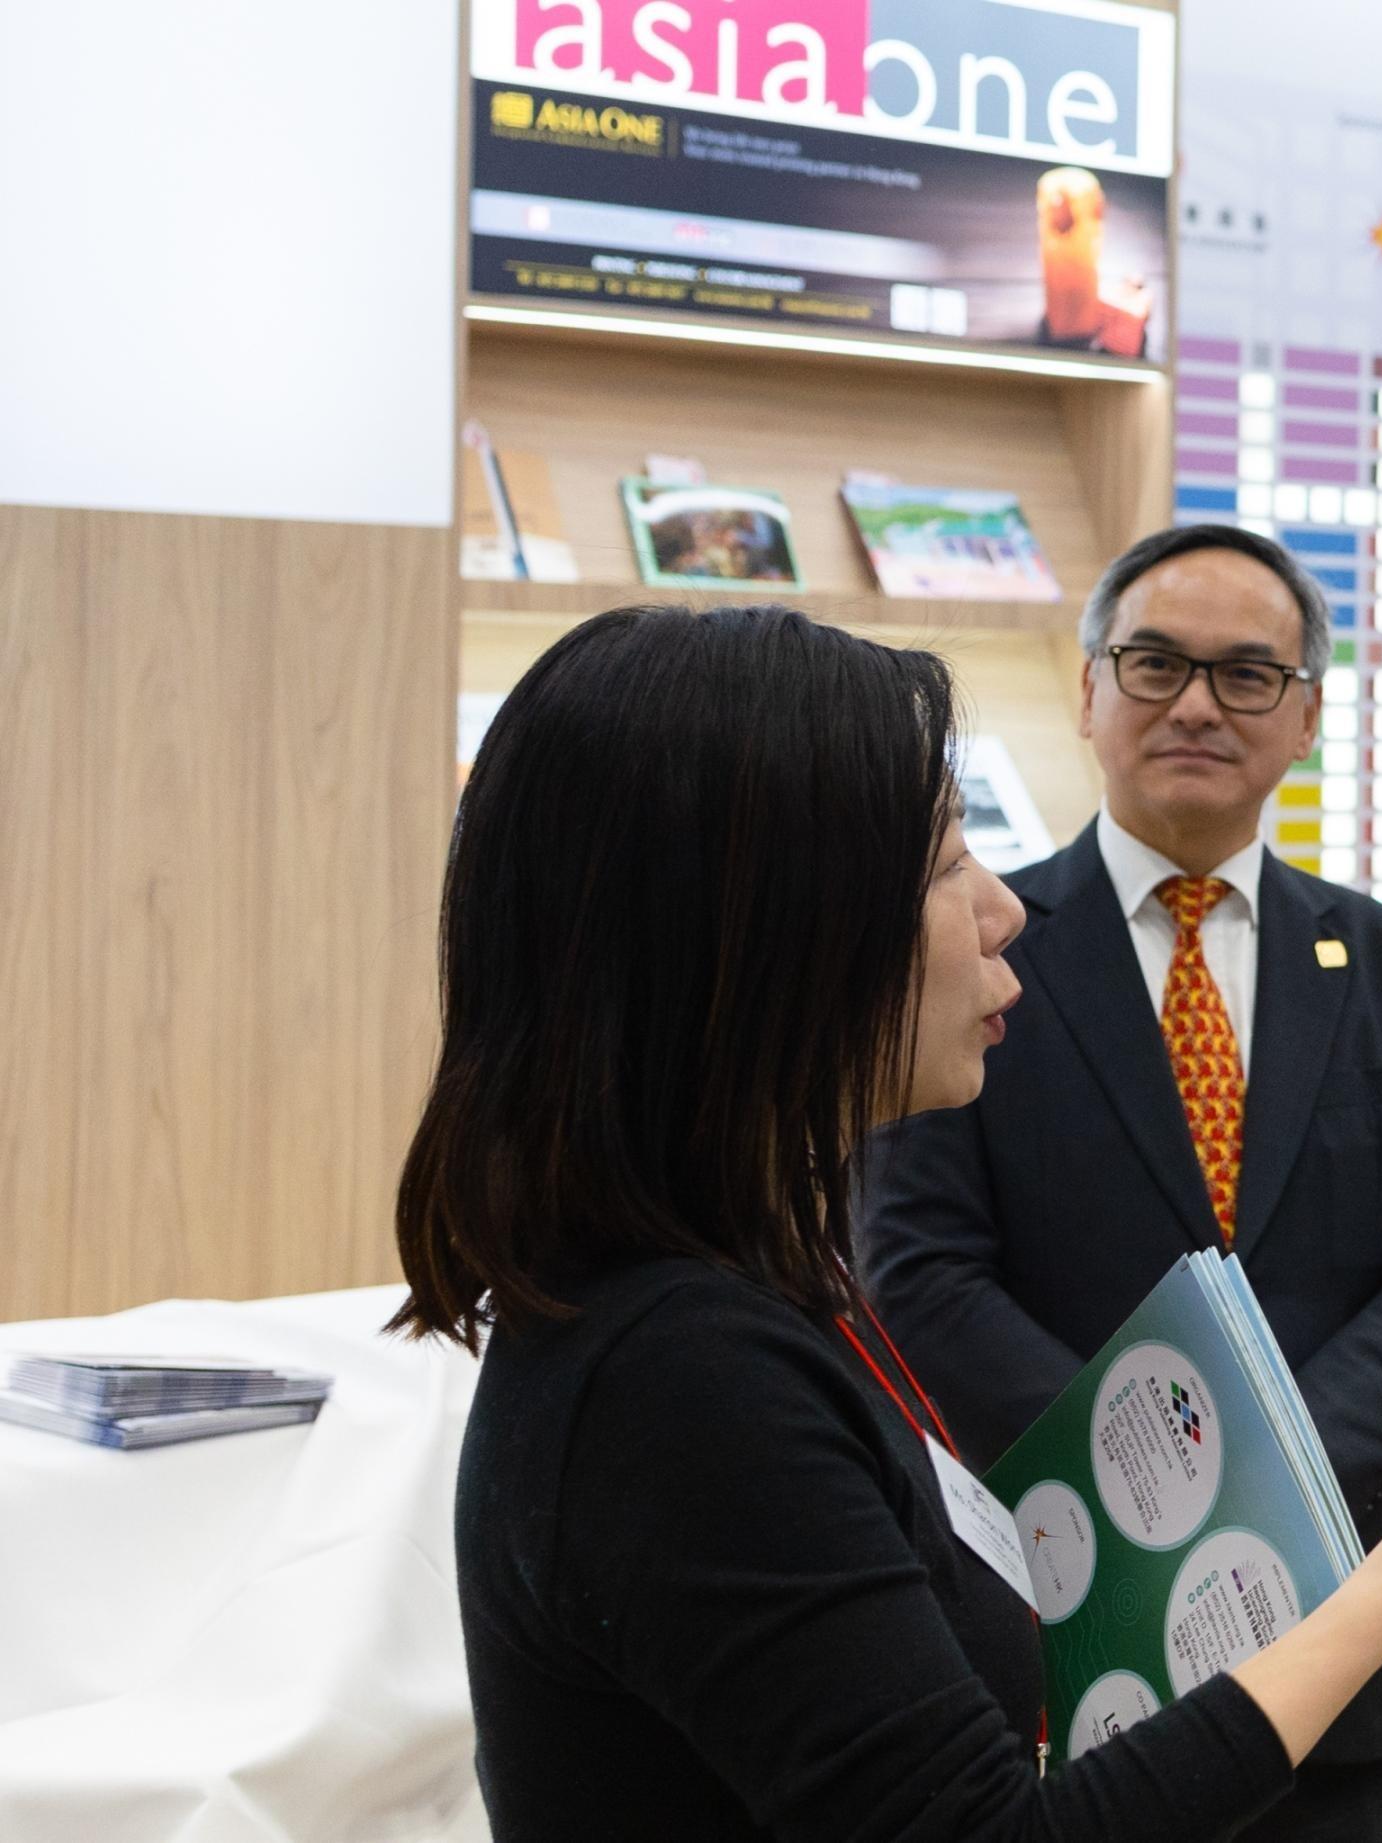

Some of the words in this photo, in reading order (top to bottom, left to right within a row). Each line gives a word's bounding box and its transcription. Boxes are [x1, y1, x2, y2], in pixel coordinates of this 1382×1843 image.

[1068, 1506, 1085, 1545] SPONSOR
[1256, 1578, 1268, 1603] Hong
[1264, 1600, 1277, 1624] Kong
[1260, 1623, 1272, 1647] Socie
[1102, 1710, 1121, 1741] LS
